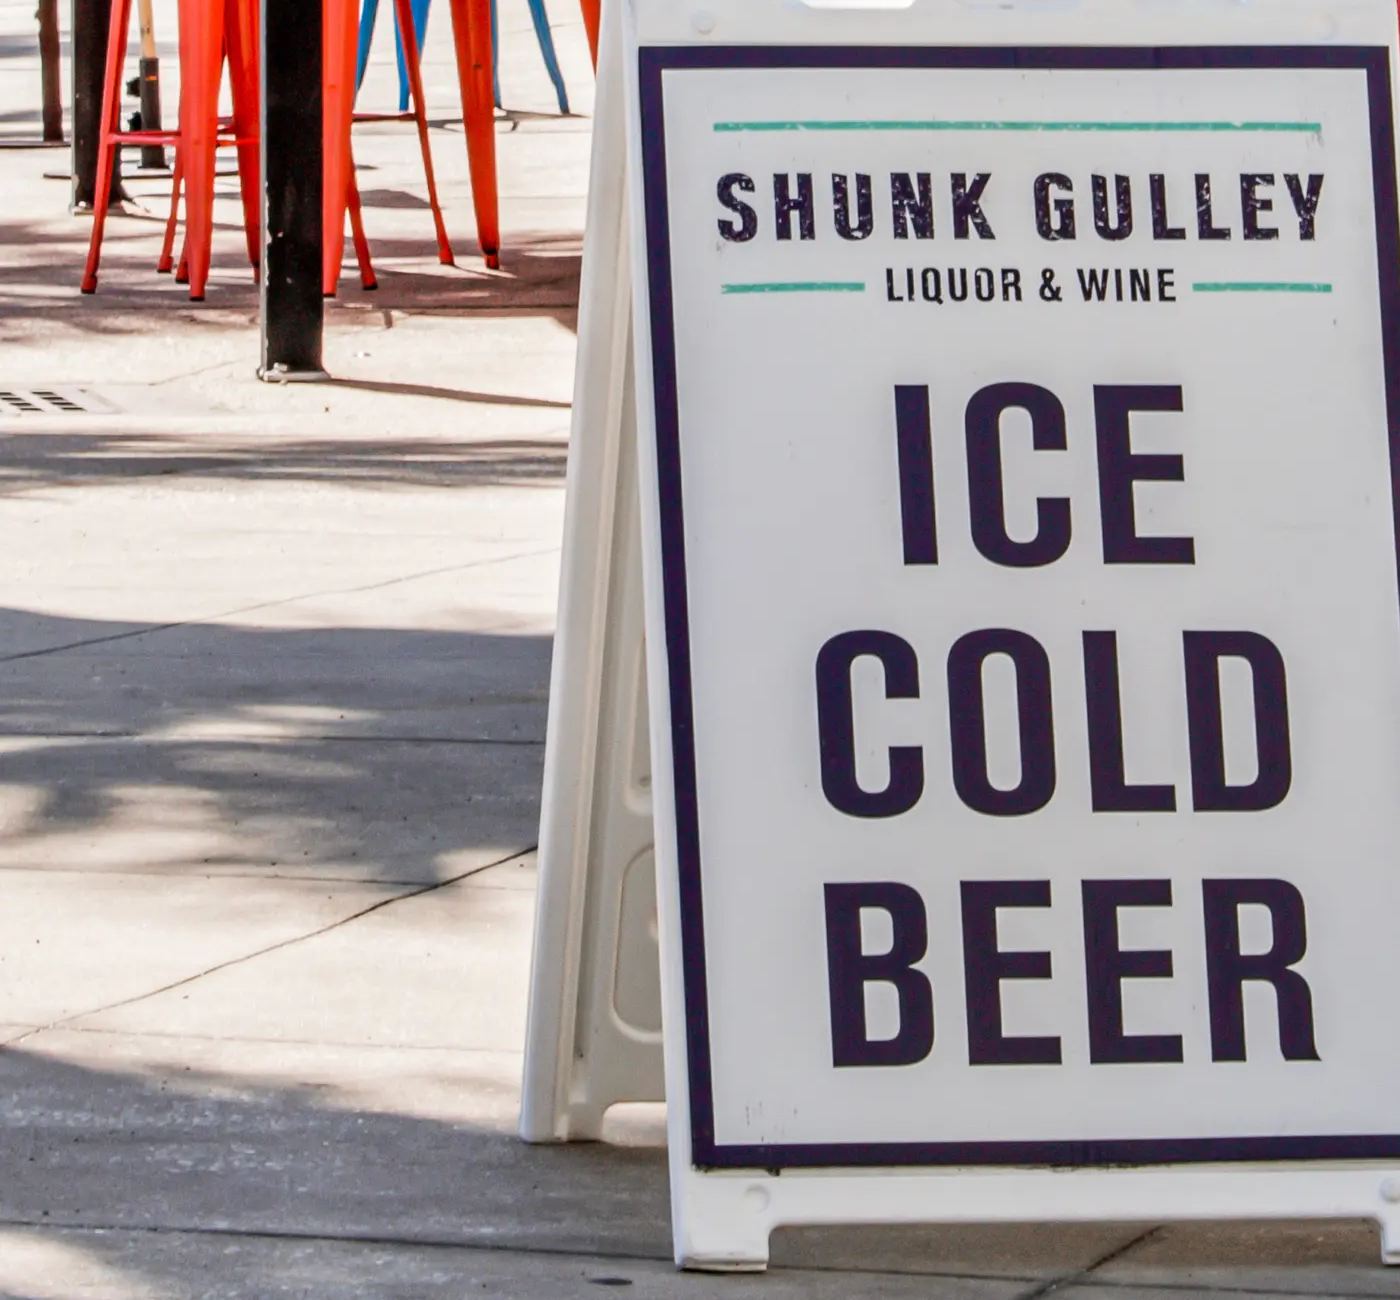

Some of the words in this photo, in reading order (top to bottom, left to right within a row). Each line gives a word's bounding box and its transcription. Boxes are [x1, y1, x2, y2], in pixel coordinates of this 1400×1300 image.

[716, 172, 996, 243] SHUNK
[1033, 172, 1325, 242] GULLEY
[885, 267, 1022, 305] LIQUOR
[1039, 268, 1063, 302] &
[1076, 268, 1177, 302] WINE
[894, 381, 1196, 568] ICE
[815, 627, 1292, 819] COLD
[823, 878, 1322, 1069] BEER
